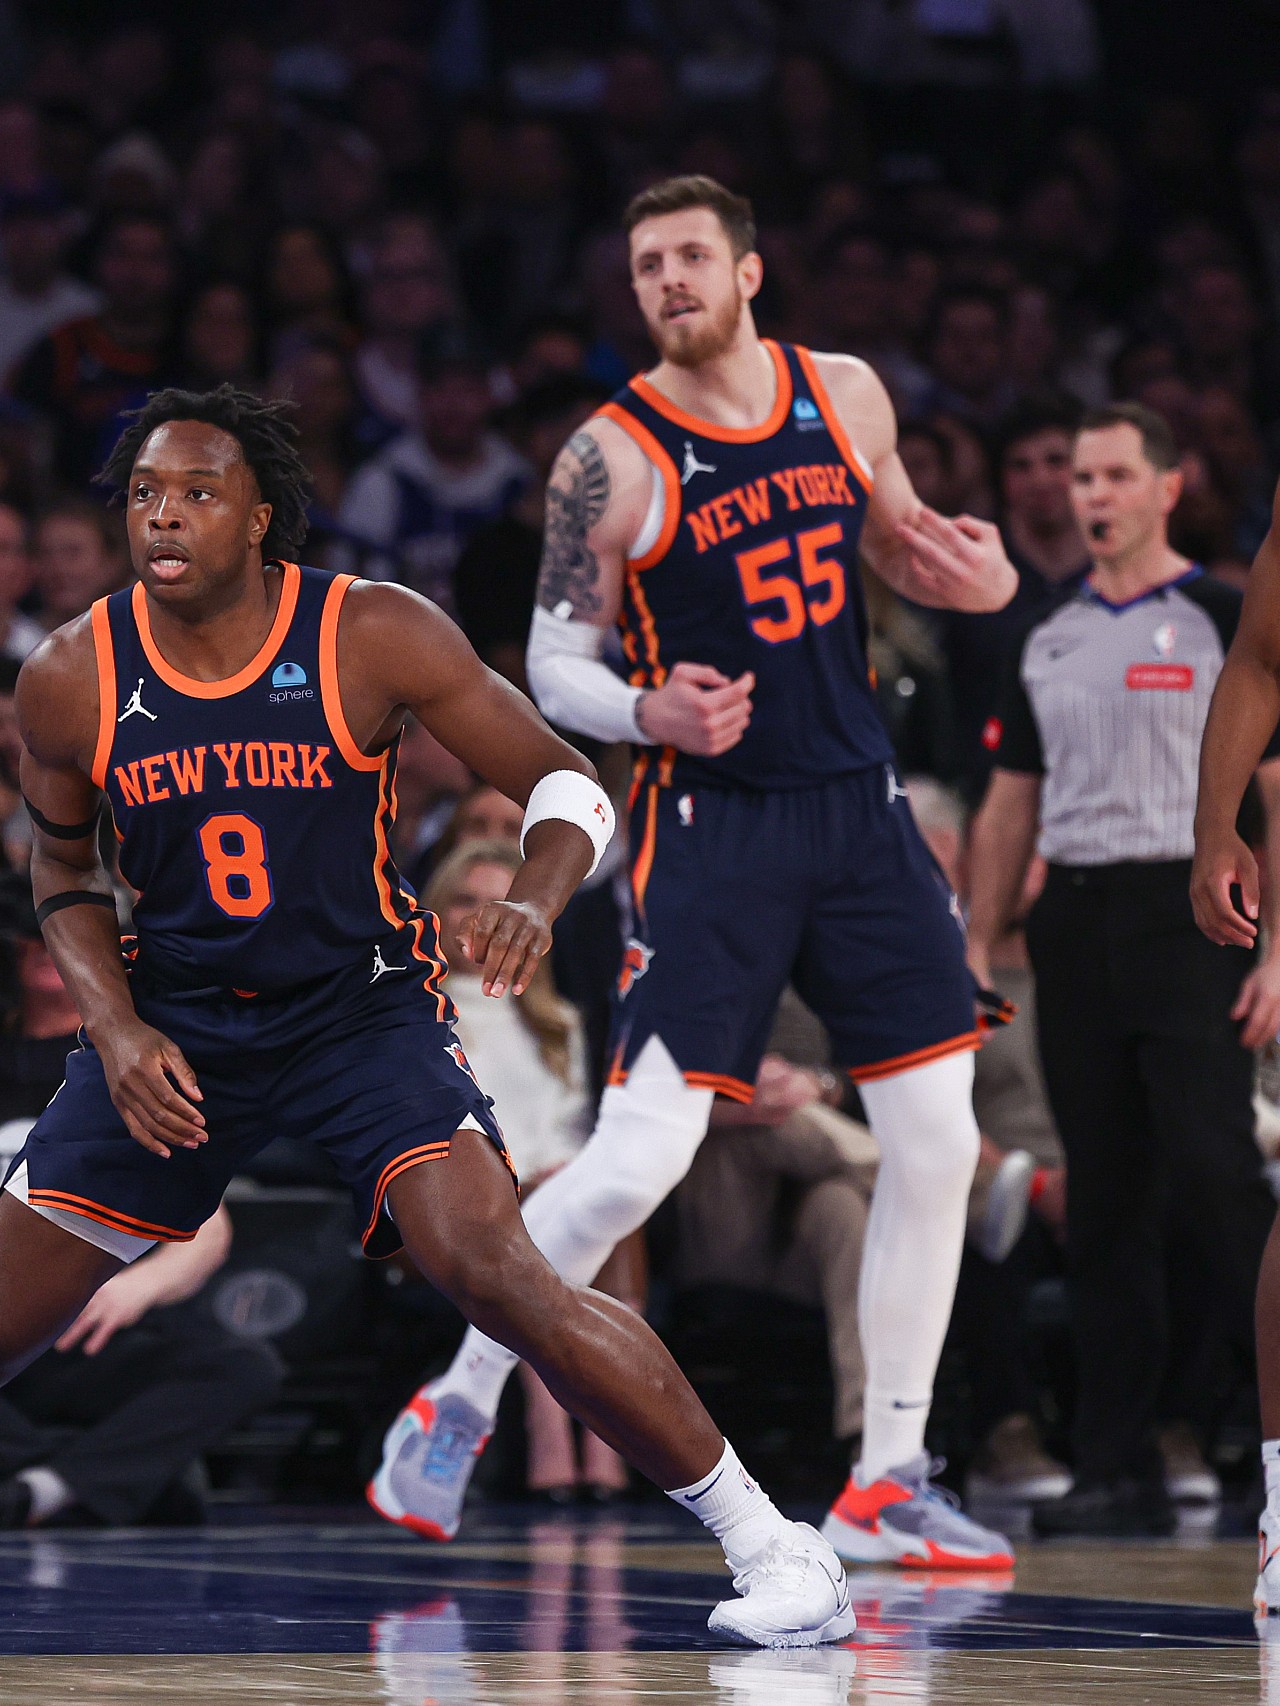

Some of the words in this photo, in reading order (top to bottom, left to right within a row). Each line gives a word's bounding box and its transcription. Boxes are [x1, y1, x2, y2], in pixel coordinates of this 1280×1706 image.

[685, 477, 771, 554] NEW
[771, 464, 856, 511] YORK
[733, 521, 847, 645] 55
[269, 689, 314, 704] sphere
[114, 746, 207, 807] NEW
[212, 741, 333, 788] YORK
[195, 810, 275, 921] 8
